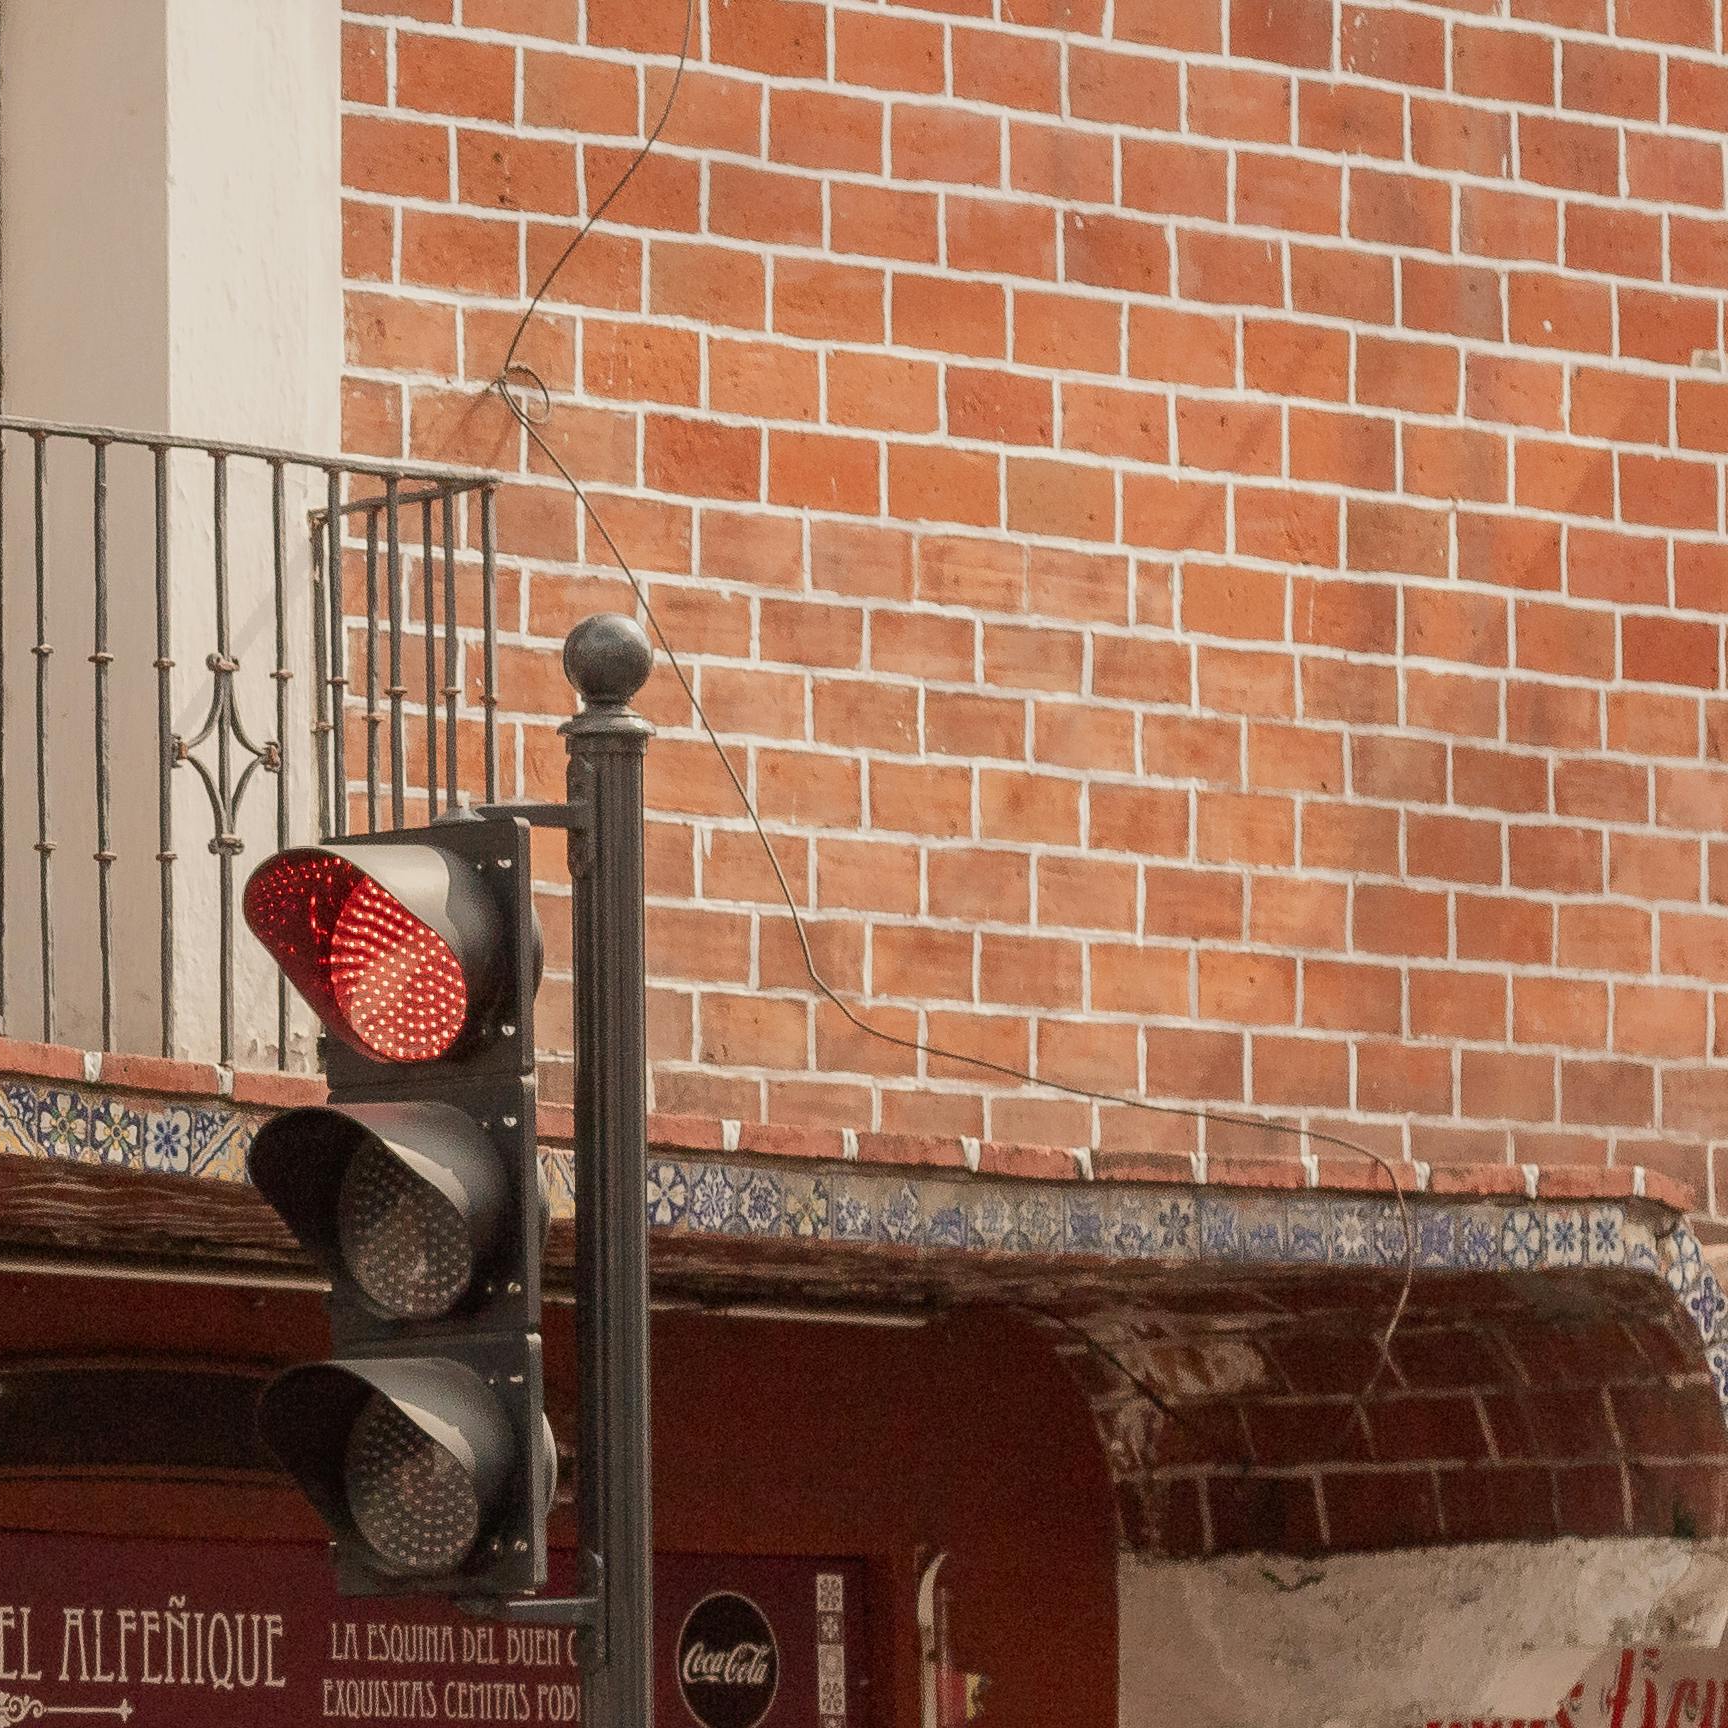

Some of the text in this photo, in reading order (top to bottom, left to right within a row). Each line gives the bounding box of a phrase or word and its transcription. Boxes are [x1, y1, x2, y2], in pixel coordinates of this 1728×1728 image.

[59, 1595, 287, 1691] ALFEÑIQUE
[330, 1624, 359, 1663] LA
[366, 1624, 456, 1666] ESQUINA
[461, 1626, 500, 1666] DEL
[507, 1627, 561, 1666] BUEN
[322, 1679, 437, 1720] EXQUISITAS
[443, 1680, 530, 1721] CEMITAS
